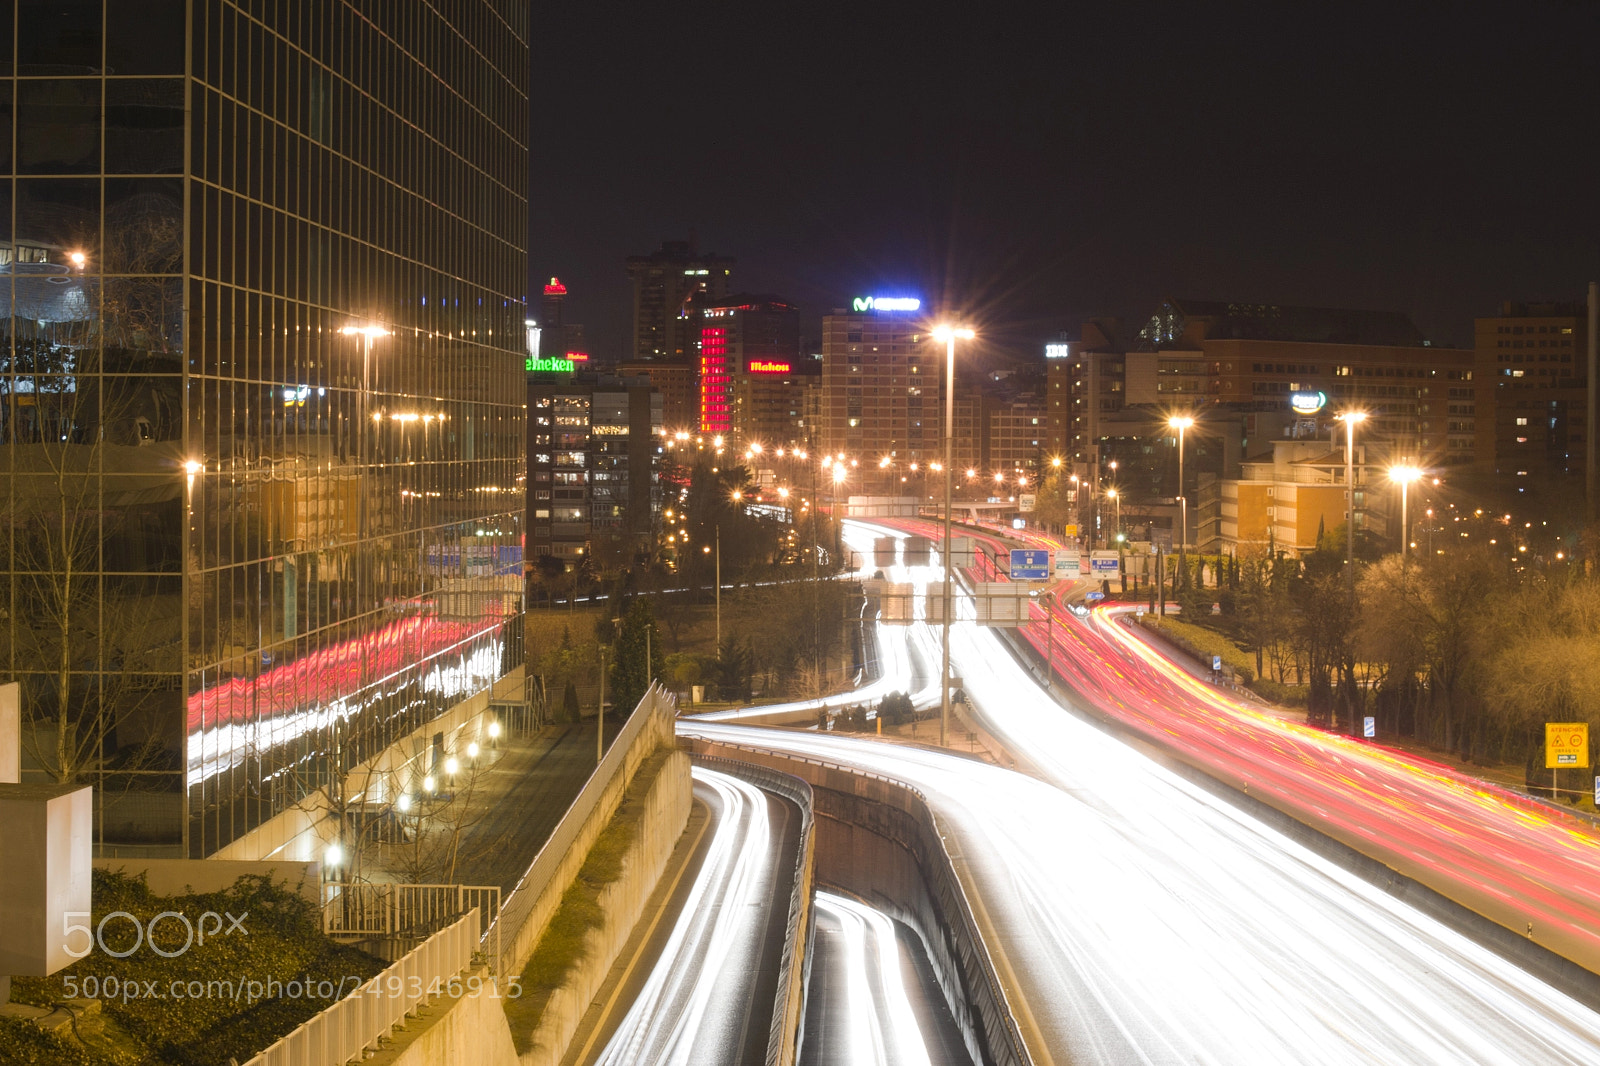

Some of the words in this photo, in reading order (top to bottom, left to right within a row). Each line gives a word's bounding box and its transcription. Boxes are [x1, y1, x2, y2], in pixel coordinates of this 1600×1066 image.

[1045, 344, 1068, 355] IBM
[525, 355, 575, 372] eineken
[750, 361, 790, 372] Mahou
